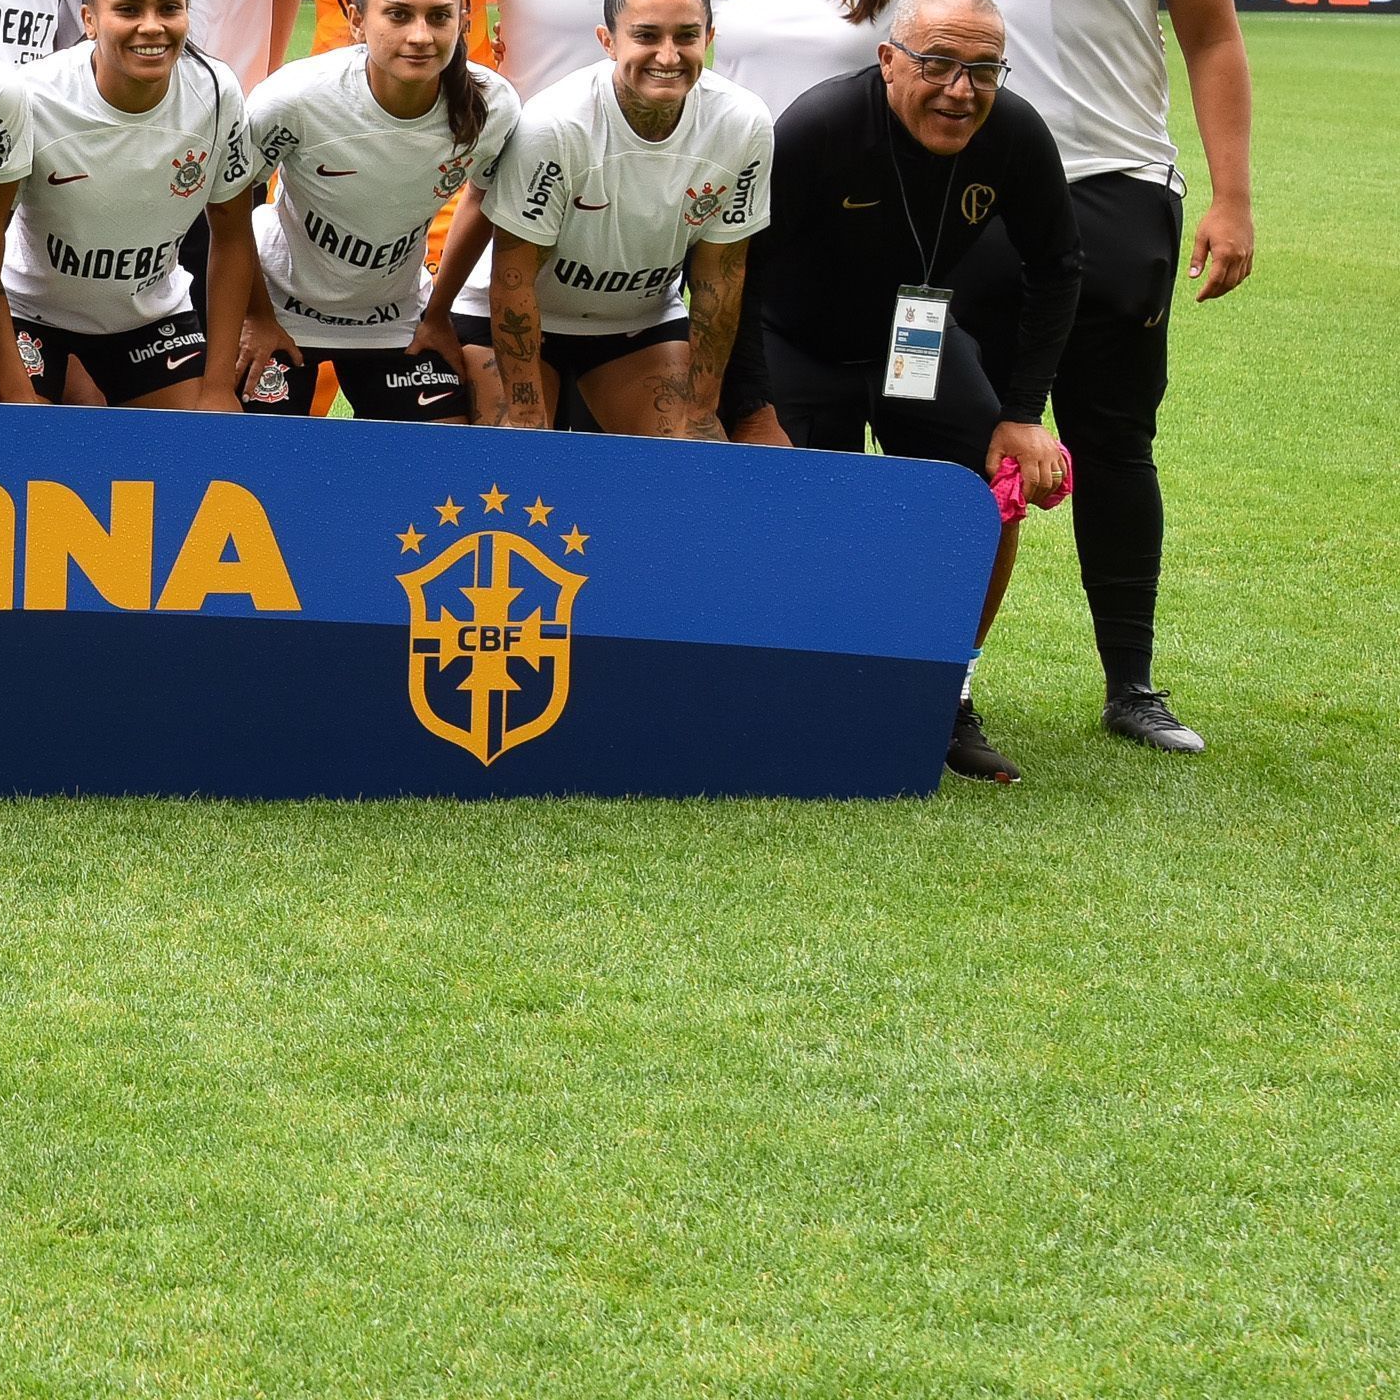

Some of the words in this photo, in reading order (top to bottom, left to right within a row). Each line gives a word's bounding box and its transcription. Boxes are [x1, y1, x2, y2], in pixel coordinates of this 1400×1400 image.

[264, 127, 300, 160] bmg
[534, 160, 564, 207] bmg
[722, 172, 758, 225] bmg
[553, 257, 683, 293] VAIDEBE
[386, 365, 461, 390] UniCesuma
[457, 625, 523, 652] CBF
